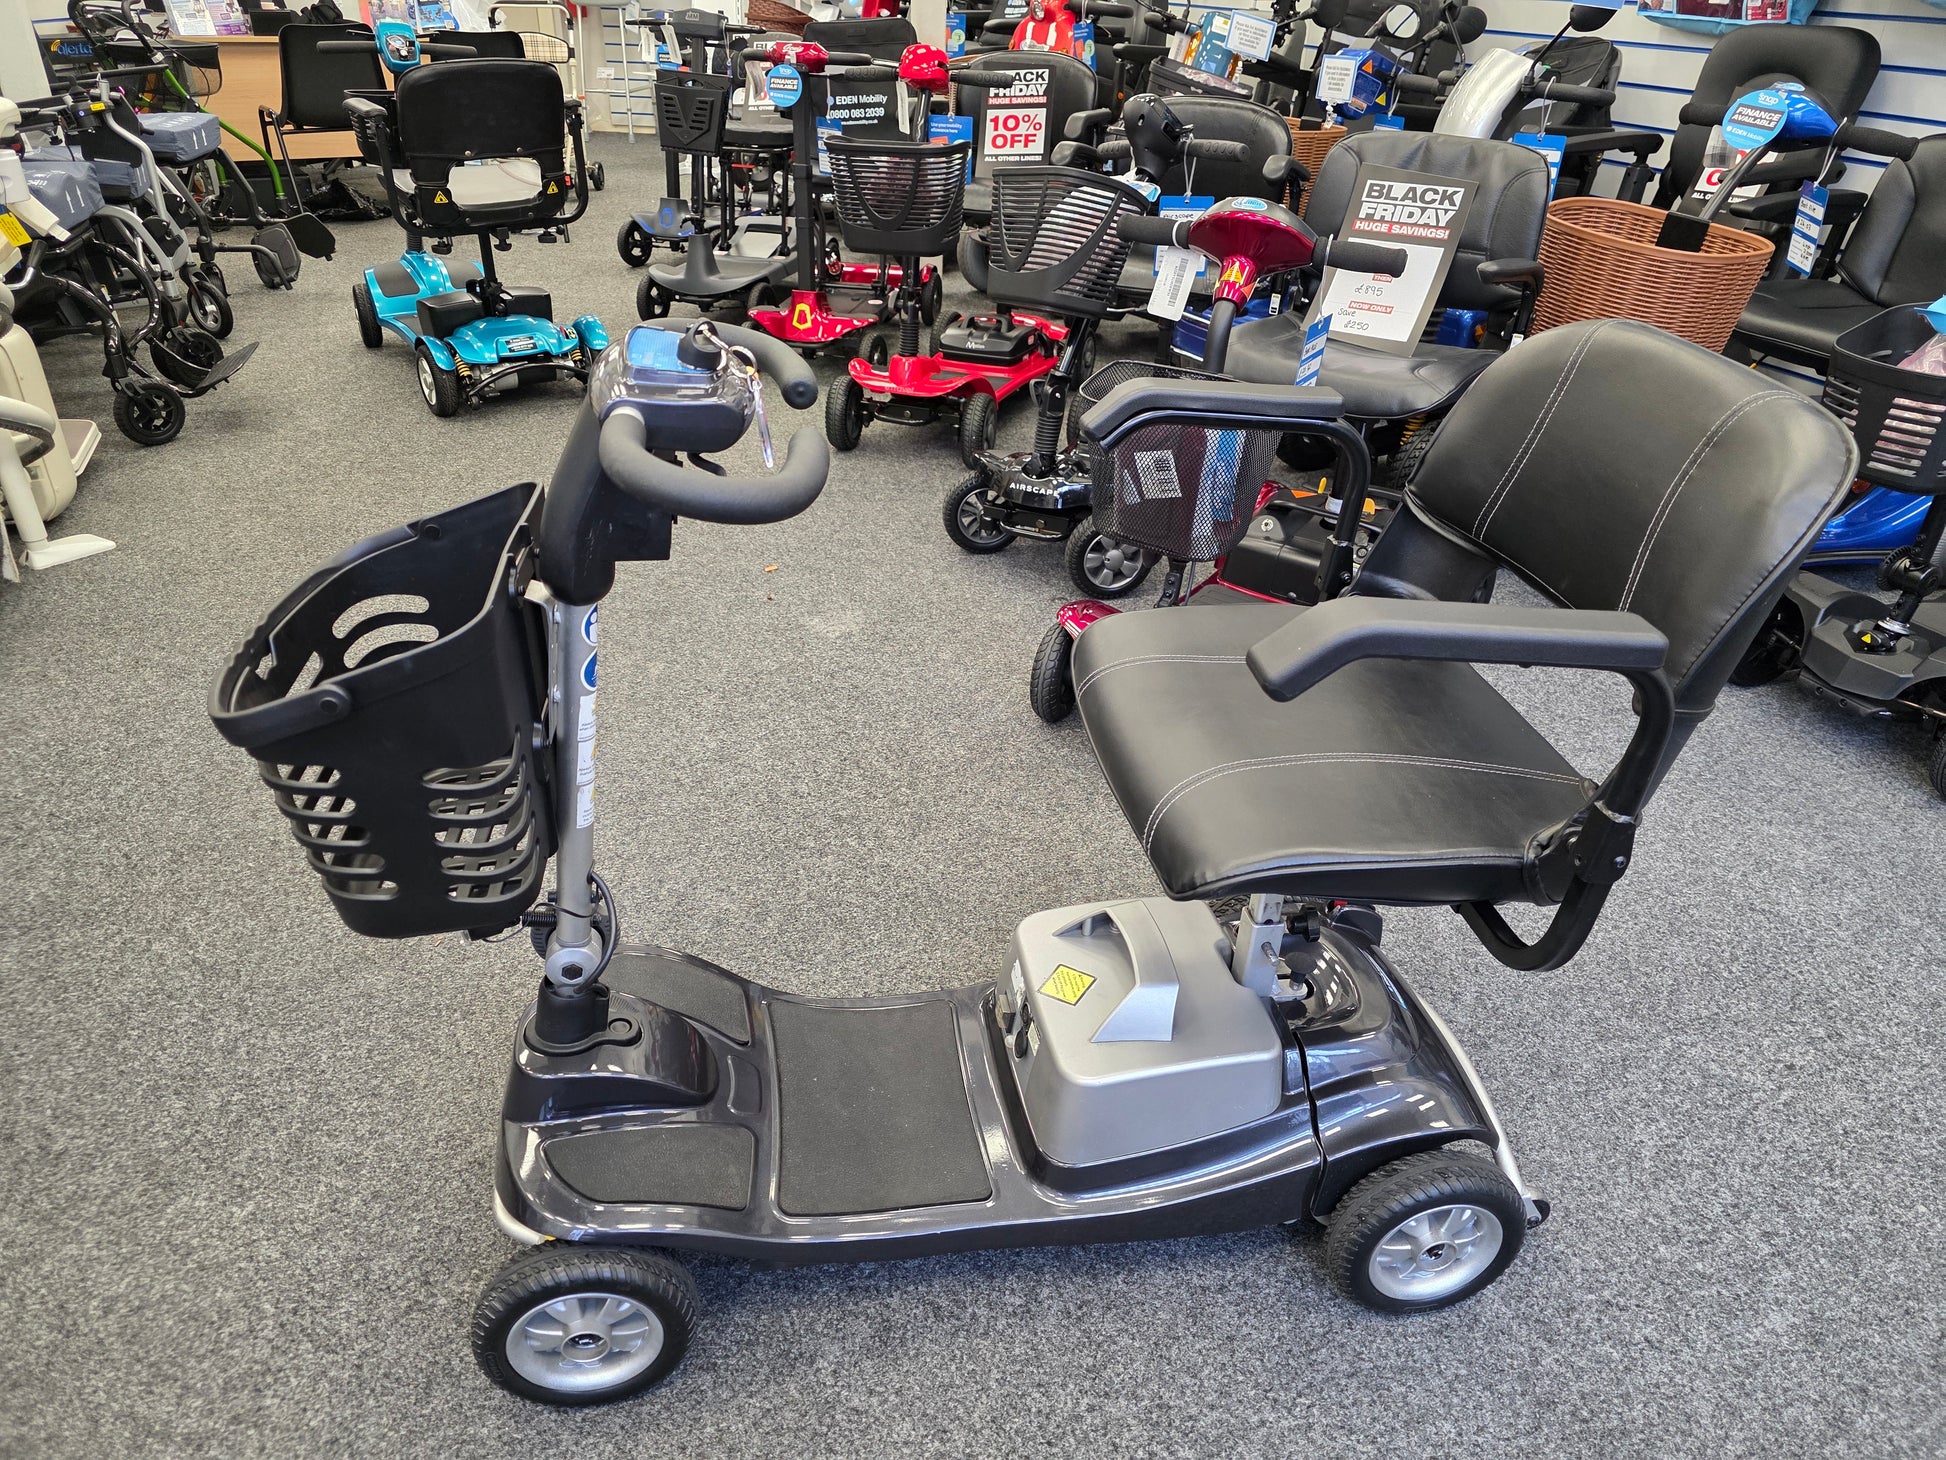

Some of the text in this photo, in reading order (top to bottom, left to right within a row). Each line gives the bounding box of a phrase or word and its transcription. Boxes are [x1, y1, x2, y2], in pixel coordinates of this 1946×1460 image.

[57, 42, 93, 55] alerta
[770, 77, 799, 85] FINANCE
[1013, 70, 1047, 83] ACK
[836, 93, 888, 105] EDEN Mobility
[988, 95, 1047, 105] HUGE SAVINGS!
[1758, 92, 1779, 105] snap
[830, 107, 885, 119] 0800 083 2039
[1735, 106, 1782, 121] FINANCE
[989, 113, 1043, 132] 10%
[1731, 113, 1778, 128] AVAILABLE
[1731, 127, 1748, 137] EDEN
[990, 133, 1038, 150] OFF
[1365, 182, 1462, 207] BLACK
[1691, 192, 1704, 200] ALL
[1358, 201, 1457, 227] FRIDAY
[1355, 220, 1450, 239] HUGE SAVINGS!
[1354, 283, 1384, 297] £895
[1337, 307, 1357, 317] Save
[1350, 301, 1394, 314] NOW ONLY
[1343, 319, 1370, 331] £250
[1009, 482, 1060, 497] AIRSCAPE
